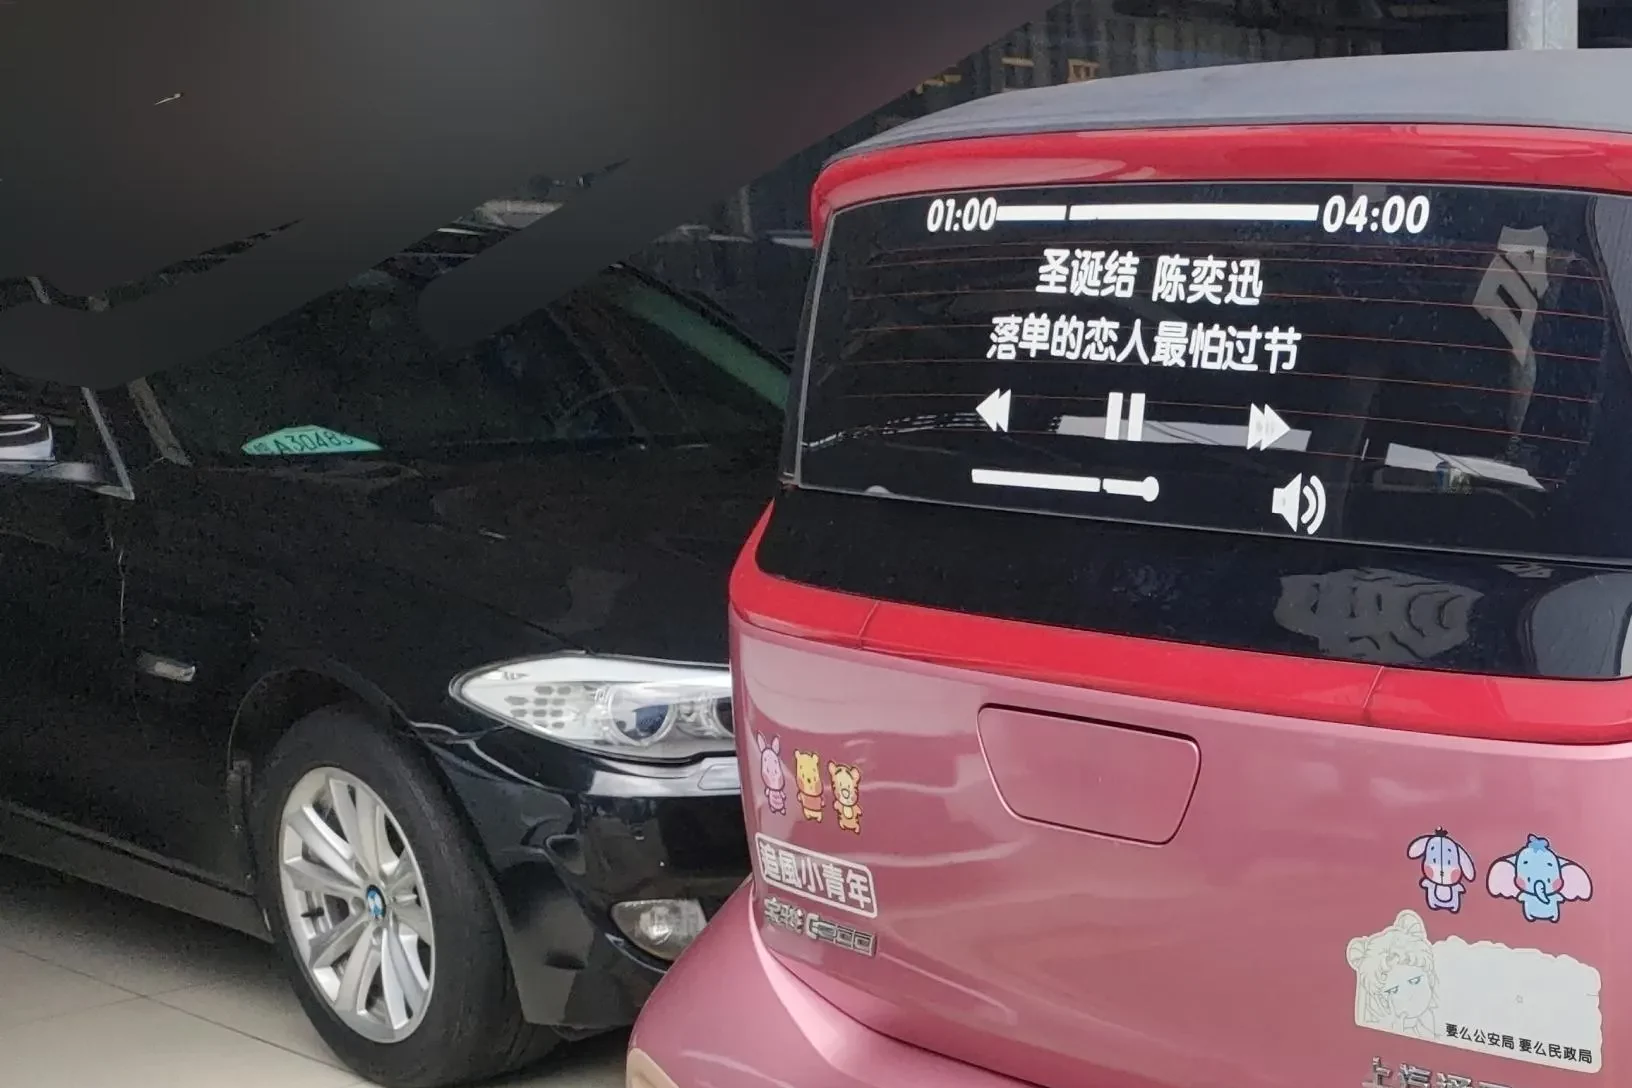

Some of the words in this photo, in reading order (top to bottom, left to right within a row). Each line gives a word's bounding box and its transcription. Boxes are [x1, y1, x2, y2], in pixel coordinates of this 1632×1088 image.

[926, 196, 997, 233] 01:00
[1321, 194, 1430, 234] 04:00
[1035, 247, 1140, 299] 圣诞结
[1151, 255, 1264, 307] 陈奕迅
[986, 312, 1302, 376] 落单的恋人最怕过节
[1445, 1022, 1516, 1050] 要么公安局
[1518, 1037, 1594, 1064] 要么民政局
